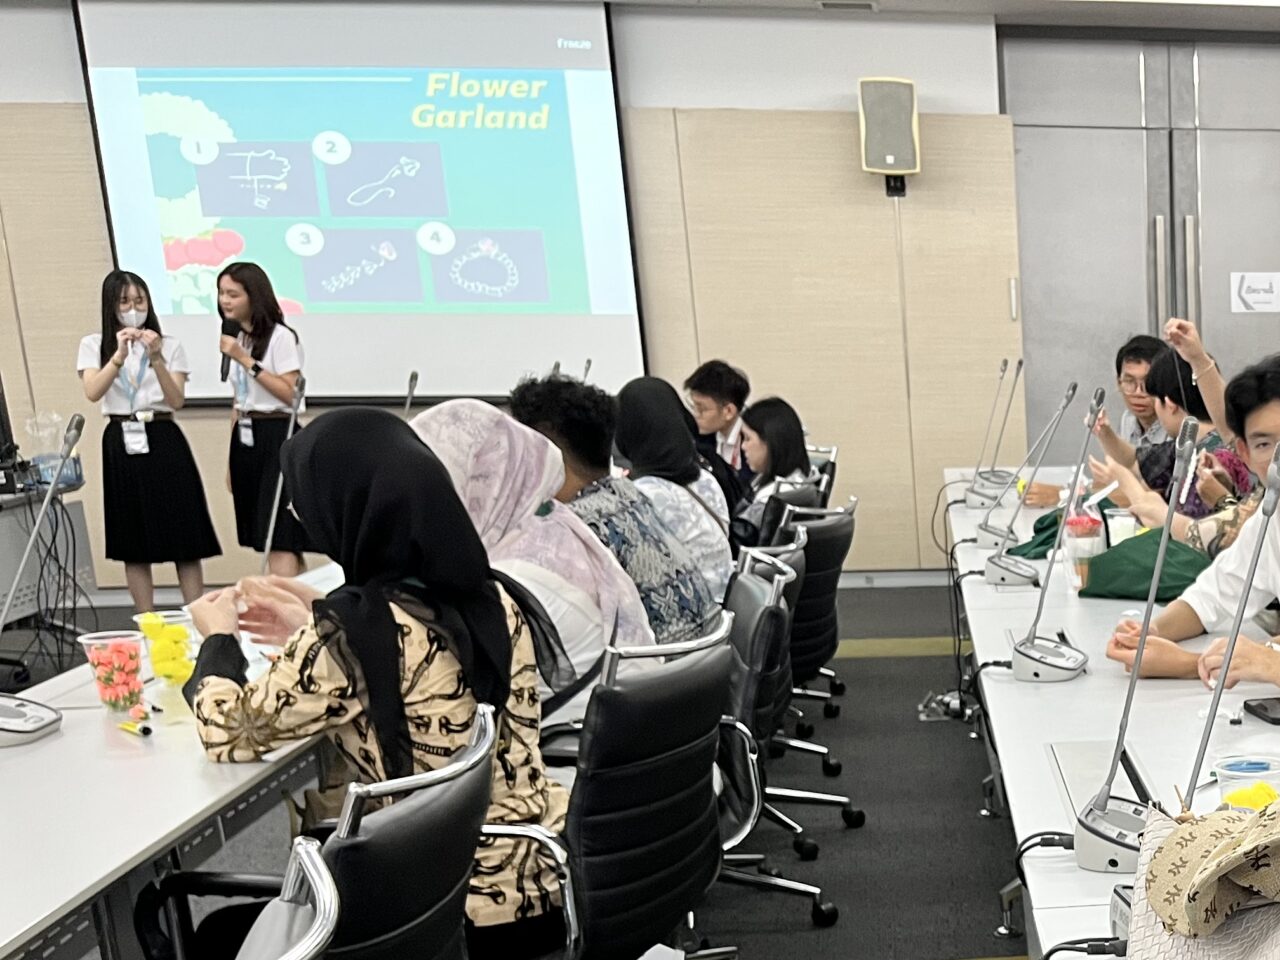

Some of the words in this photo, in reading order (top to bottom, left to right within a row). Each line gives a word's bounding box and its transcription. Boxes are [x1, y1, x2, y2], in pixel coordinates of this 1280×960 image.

[425, 71, 549, 98] Flower
[411, 103, 550, 129] Garland
[325, 140, 337, 153] 2
[299, 231, 312, 245] 3
[429, 230, 442, 244] 4
